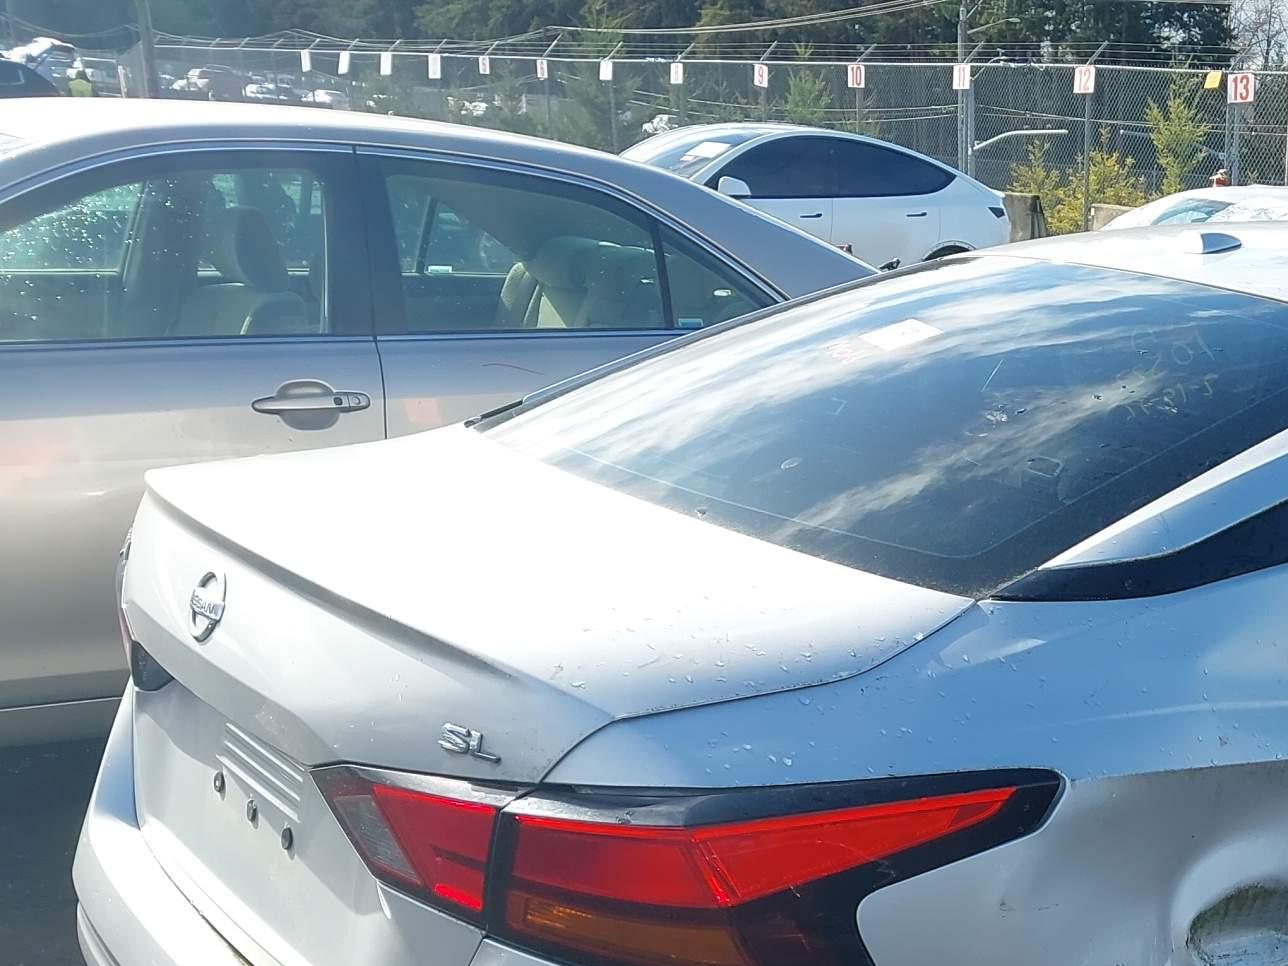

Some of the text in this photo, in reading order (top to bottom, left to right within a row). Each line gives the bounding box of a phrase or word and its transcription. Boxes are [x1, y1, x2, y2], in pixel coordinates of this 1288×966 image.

[757, 65, 765, 85] 9
[851, 66, 862, 87] 10
[958, 66, 966, 88] 11
[1078, 67, 1091, 92] 12
[1232, 74, 1250, 101] 13
[438, 721, 502, 766] SL
